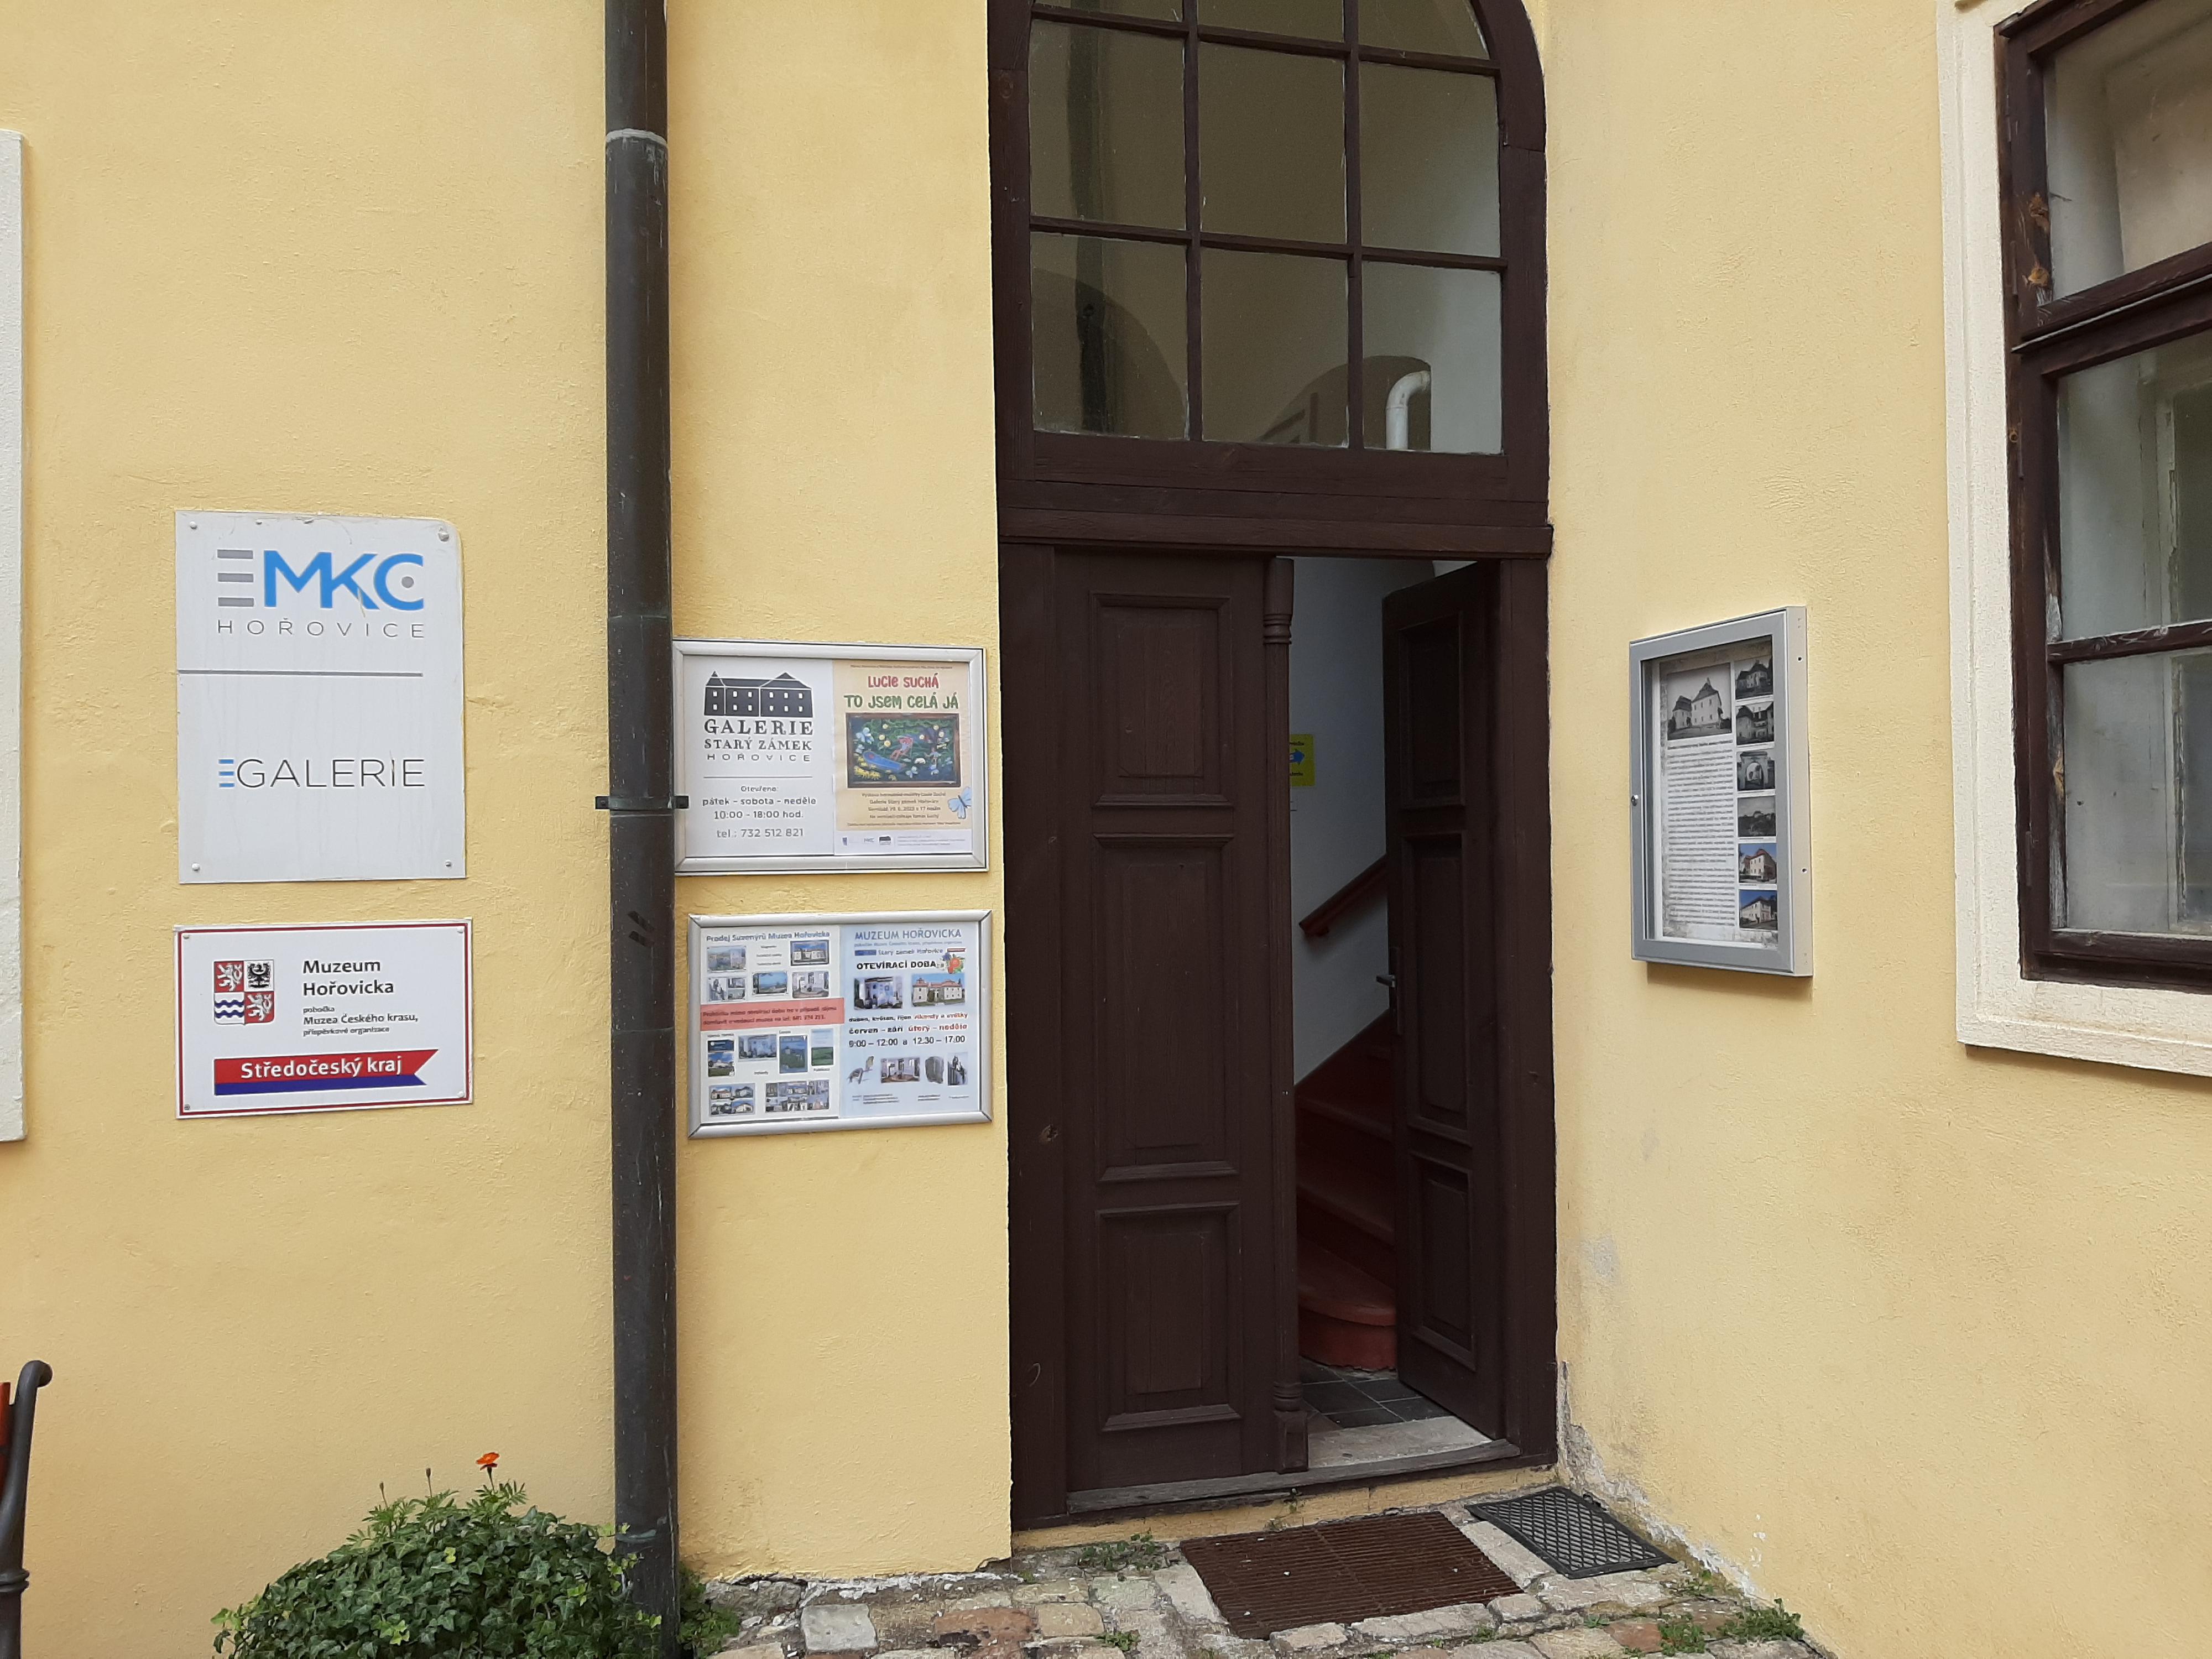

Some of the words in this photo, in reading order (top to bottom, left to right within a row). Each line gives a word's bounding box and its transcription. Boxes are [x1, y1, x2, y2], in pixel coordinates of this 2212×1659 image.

[217, 617, 425, 638] HOŘOVICE
[844, 695, 863, 708] TO
[868, 695, 902, 709] JSEM
[943, 692, 959, 709] JÁ
[704, 719, 813, 735] GALERIE
[704, 737, 753, 749] STARÝ
[758, 738, 812, 750] ZÁMEK
[707, 752, 811, 762] HOŘOVICE
[237, 758, 425, 788] GALERIE
[702, 797, 730, 806] pátek
[714, 811, 743, 819] 10:00
[754, 810, 780, 818] 18:00
[782, 810, 804, 818] hod.
[740, 829, 761, 837] 732
[765, 828, 782, 837] 512
[785, 828, 804, 837] 821
[855, 930, 899, 940] MUZEUM
[902, 927, 962, 938] HOŘOVICKA
[302, 959, 380, 973] Muzeum
[857, 960, 907, 969] OTEVÍRACÍ
[910, 960, 937, 968] DOBA
[302, 979, 394, 996] Hořovicka
[304, 1016, 338, 1025] Muzea
[341, 1013, 385, 1024] Českého
[387, 1013, 418, 1022] krasu,
[350, 1026, 390, 1035] organizace
[241, 1057, 364, 1079] Středočeský
[367, 1055, 402, 1076] kraj
